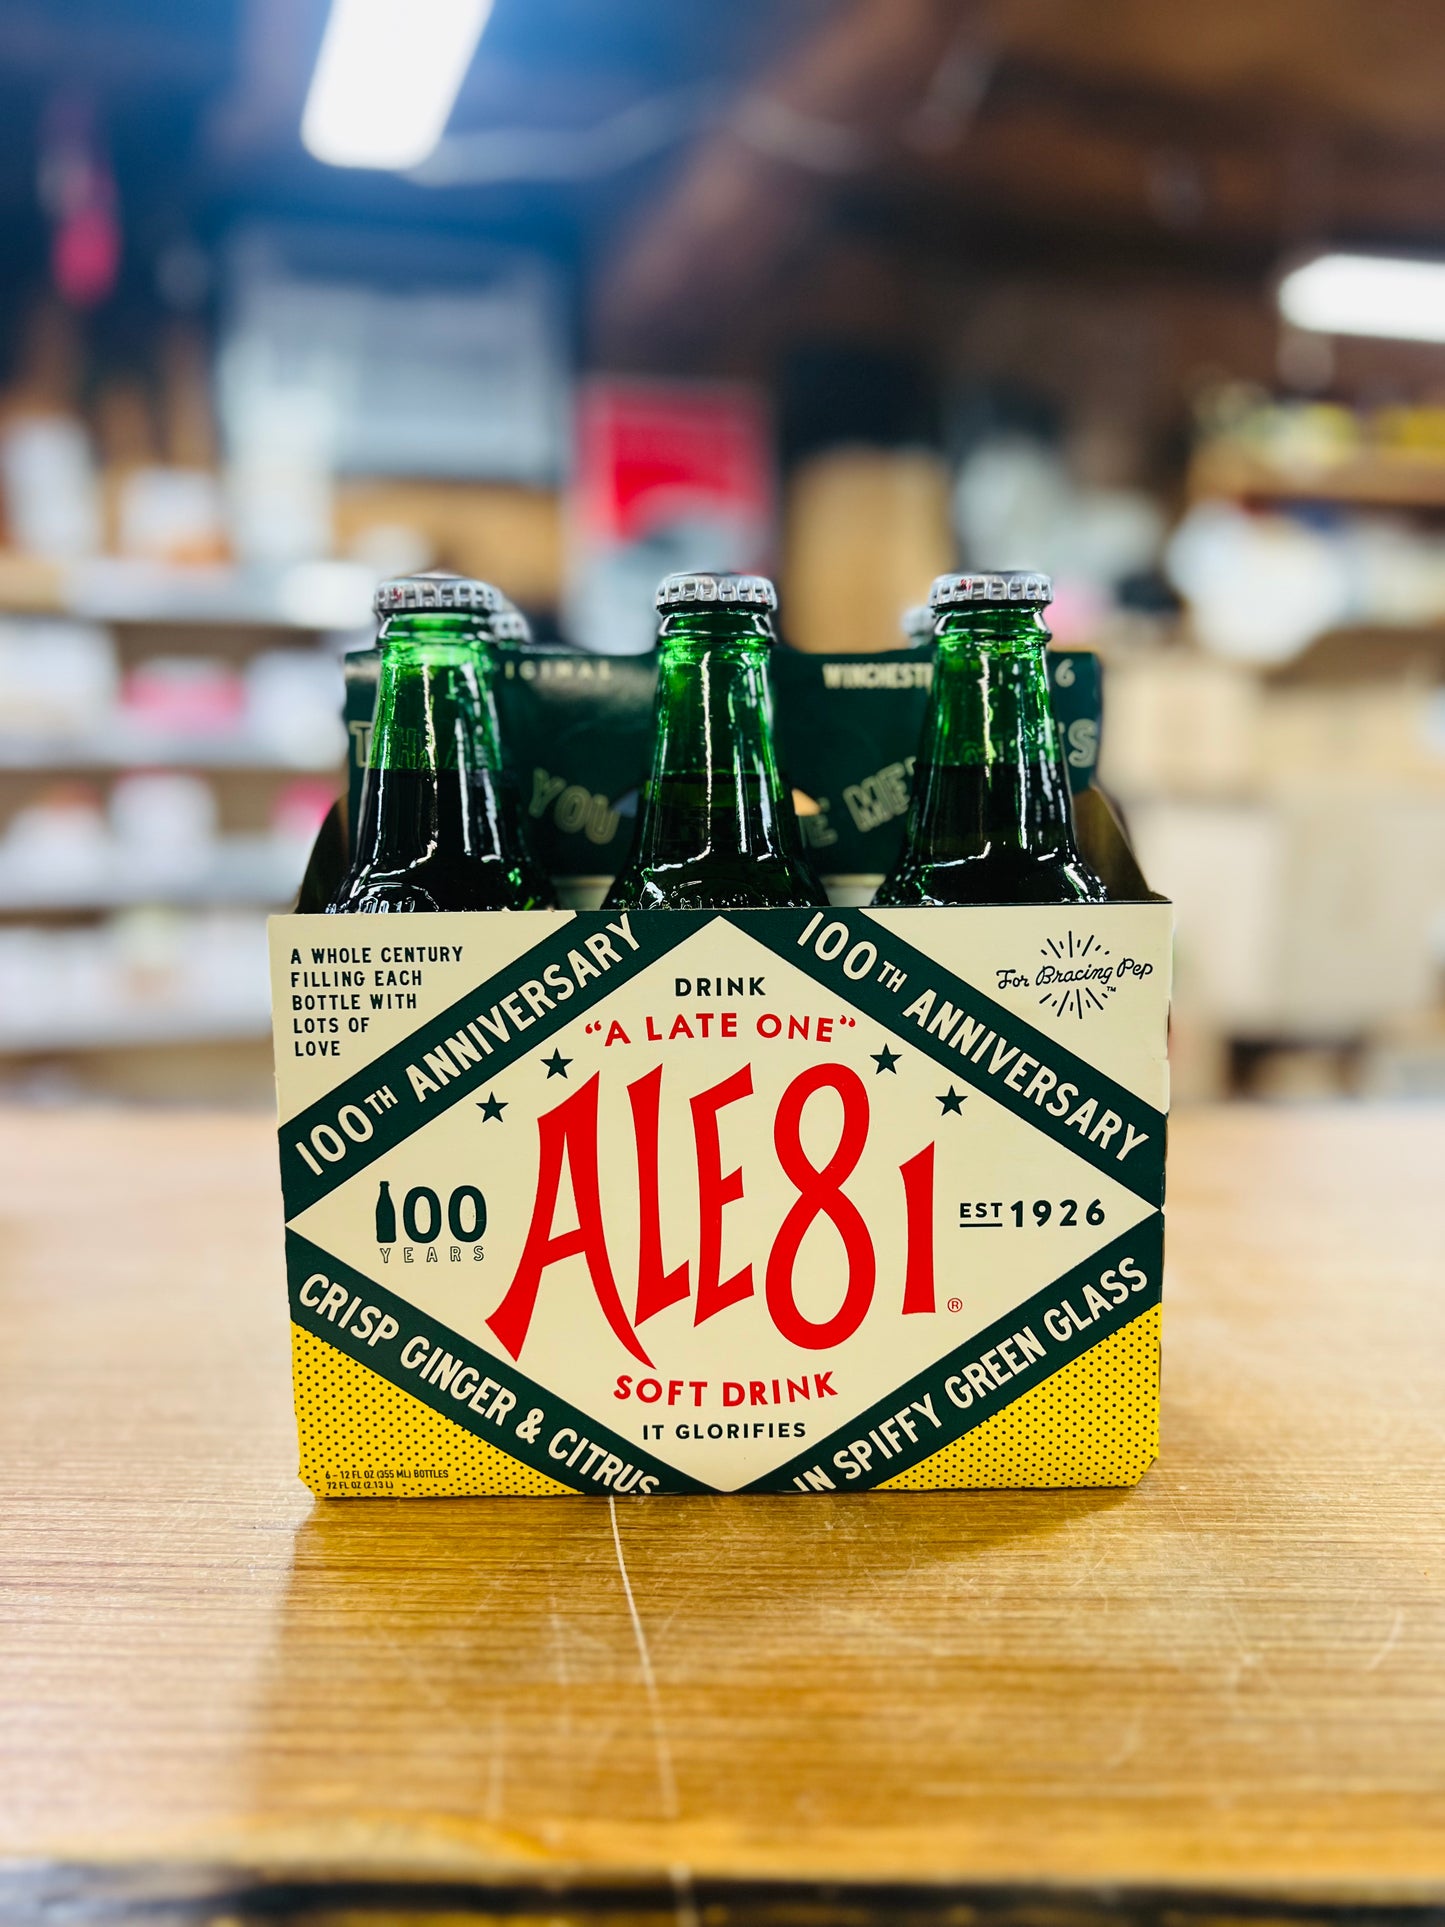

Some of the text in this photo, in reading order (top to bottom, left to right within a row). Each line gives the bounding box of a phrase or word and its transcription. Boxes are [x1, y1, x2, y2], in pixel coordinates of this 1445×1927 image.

[505, 660, 611, 680] IGINAL
[291, 946, 463, 965] A WHOLE CENTURY
[291, 970, 422, 987] FILLING EACH
[996, 957, 1153, 989] For Bracing Pep
[675, 976, 765, 997] DRINK
[292, 993, 417, 1011] BOTTLE WITH
[293, 1017, 370, 1034] LOTS OF
[646, 1013, 737, 1041] LATE
[295, 913, 640, 1176] 100TH ANNIVERSARY
[797, 911, 1149, 1162] 100TH ANNIVERSARY
[294, 1041, 340, 1056] LOVE
[960, 1199, 1105, 1228] EST 1926
[380, 1246, 485, 1263] YEARS
[299, 1273, 660, 1494] CRISP GINGER & CITRUS
[793, 1256, 1148, 1492] IN SPIFFY GREEN GLASS
[614, 1371, 838, 1407] SOFT DRINK
[643, 1422, 806, 1440] IT GLORIFIES
[325, 1471, 331, 1479] 6
[340, 1470, 350, 1479] 12
[352, 1470, 362, 1479] FL
[364, 1470, 374, 1479] OZ
[377, 1470, 394, 1479] (355
[397, 1469, 411, 1479] ML)
[414, 1469, 449, 1478] BOTTLES
[327, 1480, 394, 1489] 72 FL OZ (2.13 L)
